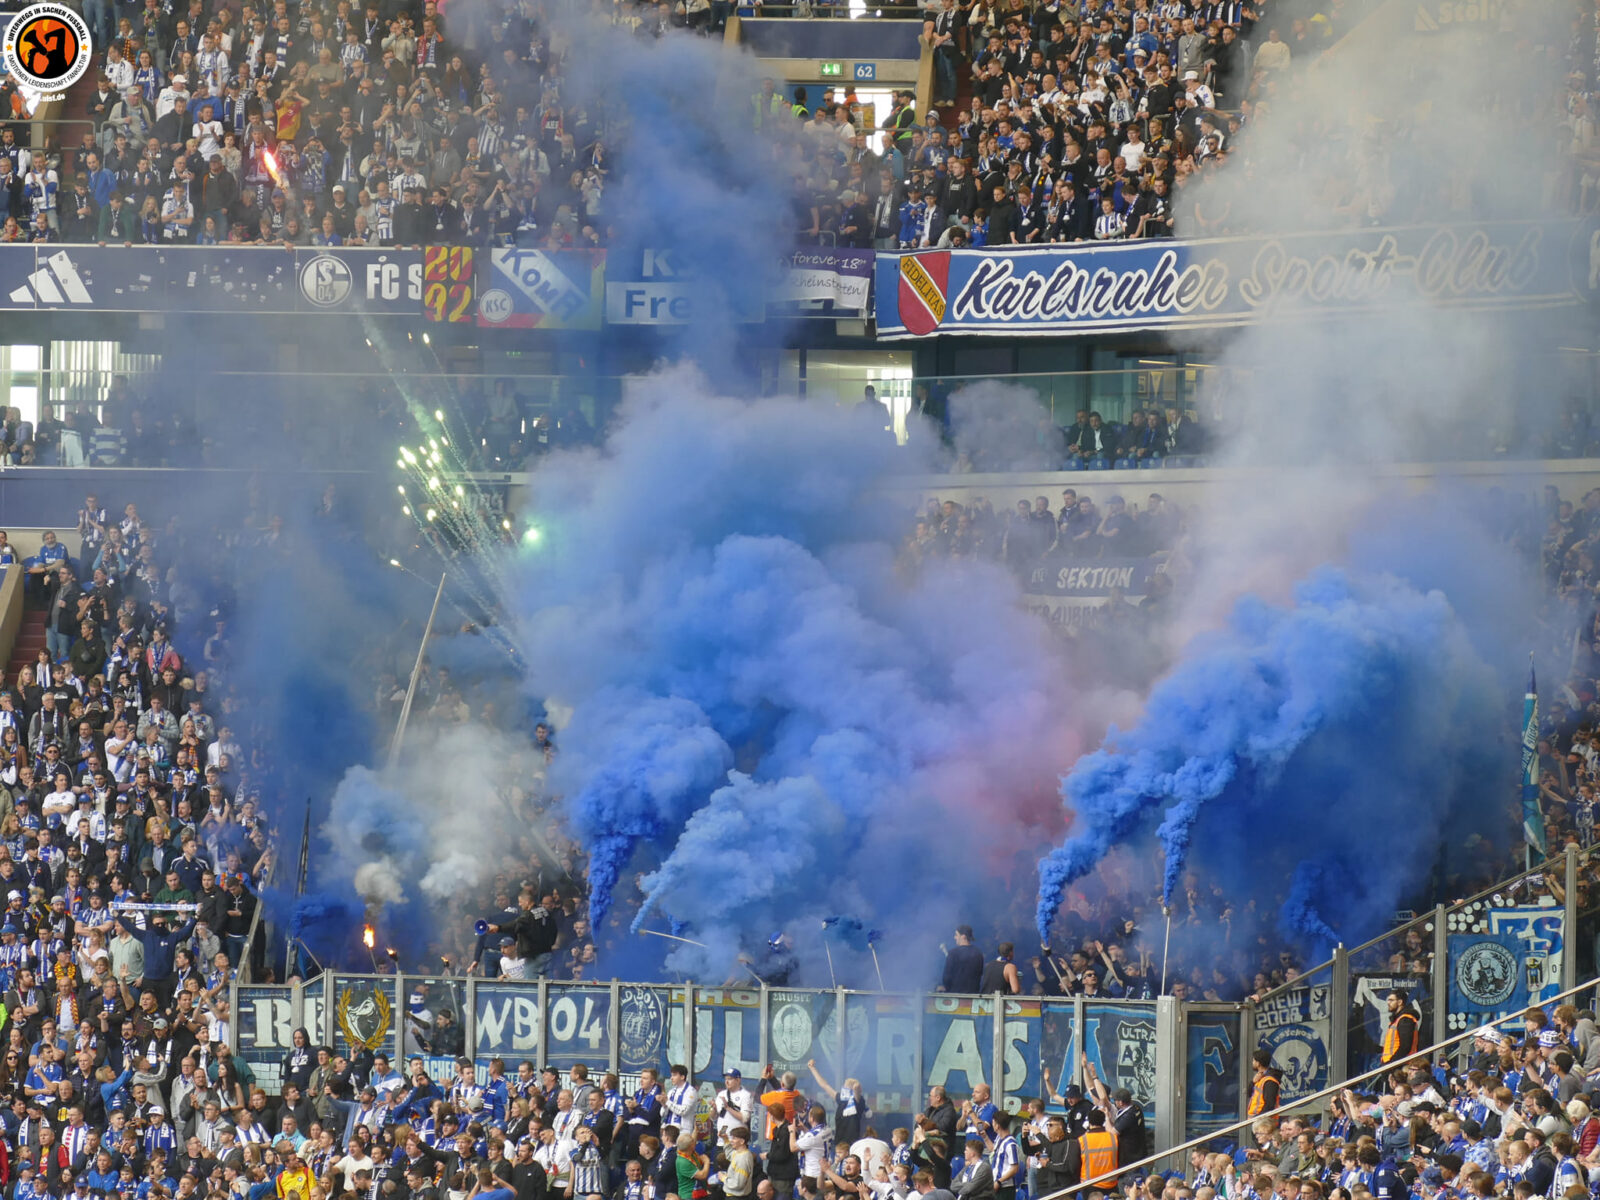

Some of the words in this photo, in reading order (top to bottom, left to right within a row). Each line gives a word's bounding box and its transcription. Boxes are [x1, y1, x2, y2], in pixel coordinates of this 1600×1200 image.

[857, 66, 873, 78] 62
[792, 251, 840, 268] forever
[366, 263, 400, 300] FC
[407, 263, 423, 300] S
[901, 257, 944, 317] FIDELITAS
[953, 249, 1229, 321] Karlsruher
[485, 298, 508, 313] KSC
[625, 290, 690, 318] Fre
[1056, 567, 1135, 589] SEKTION
